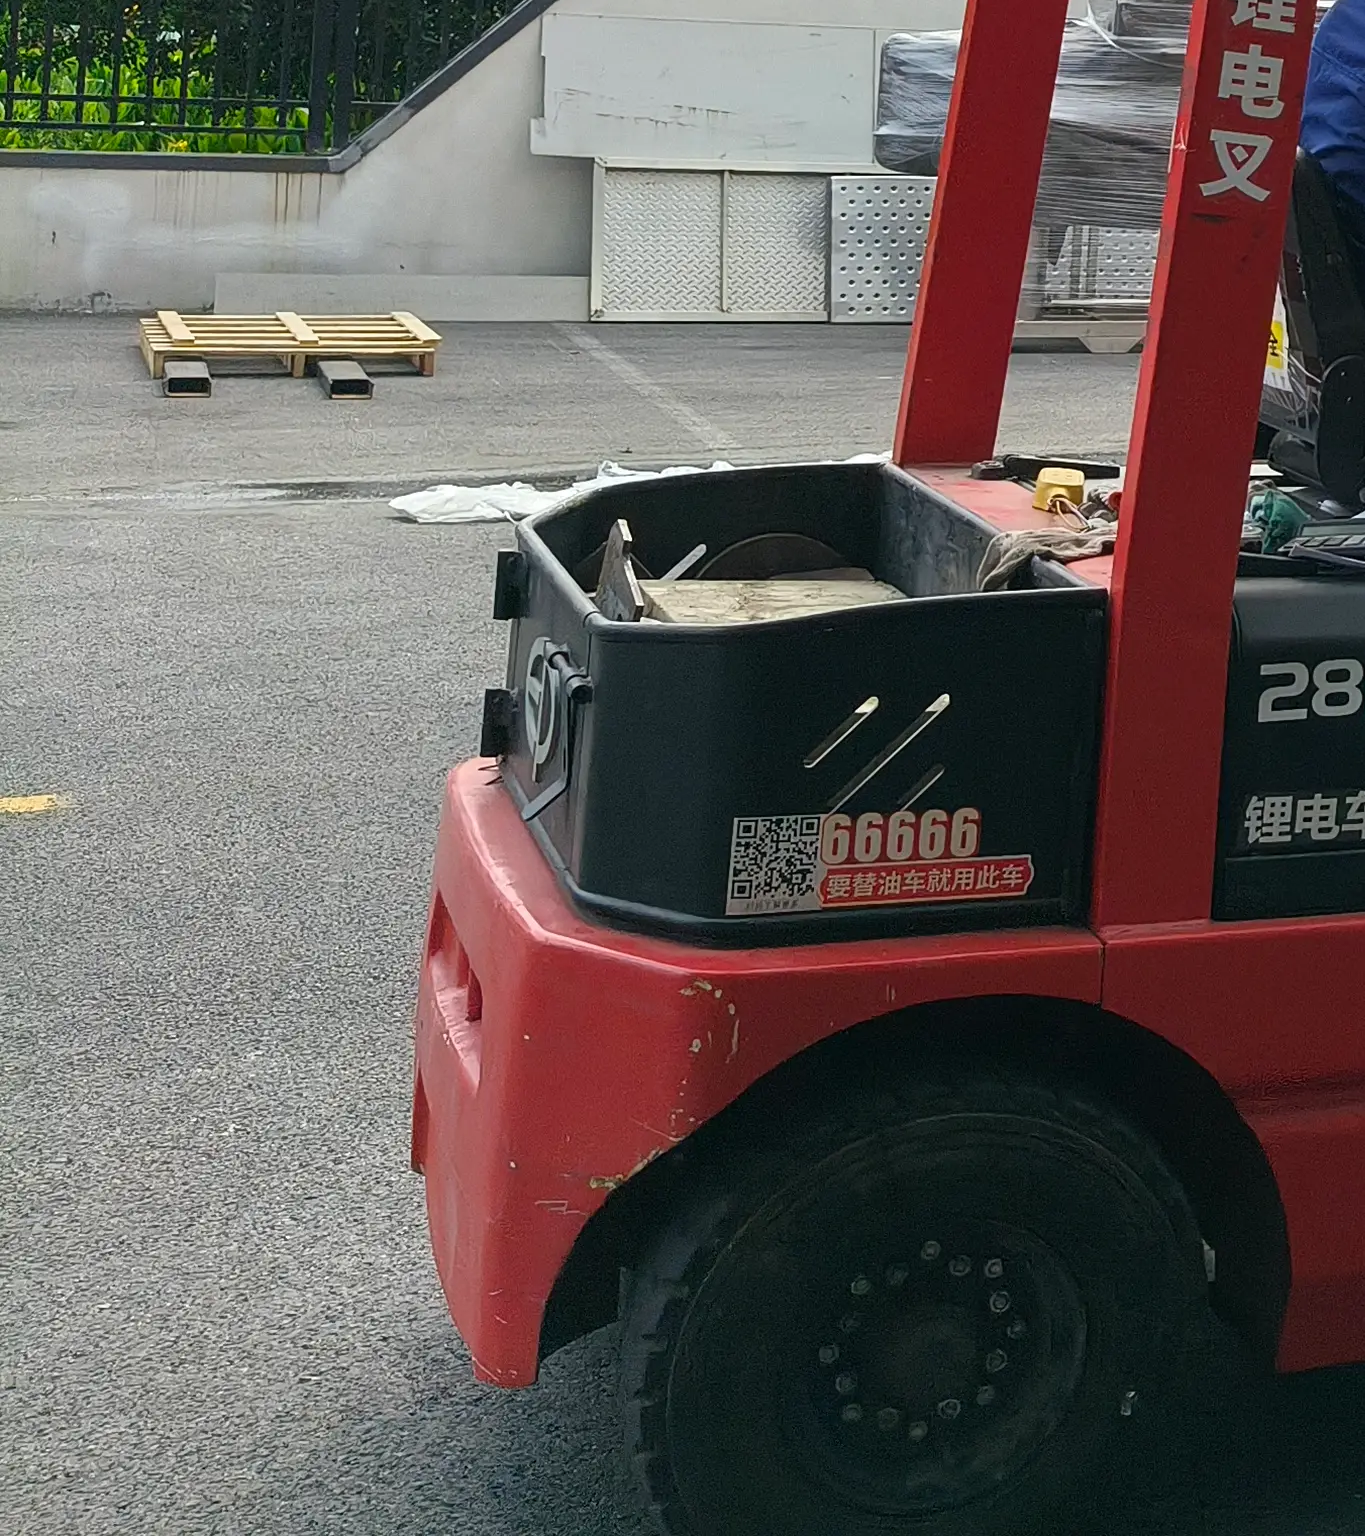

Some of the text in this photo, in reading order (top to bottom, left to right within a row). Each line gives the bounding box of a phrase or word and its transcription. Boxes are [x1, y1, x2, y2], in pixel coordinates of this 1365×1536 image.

[823, 808, 979, 864] 66666
[826, 864, 1024, 899] 要替油车就用此车
